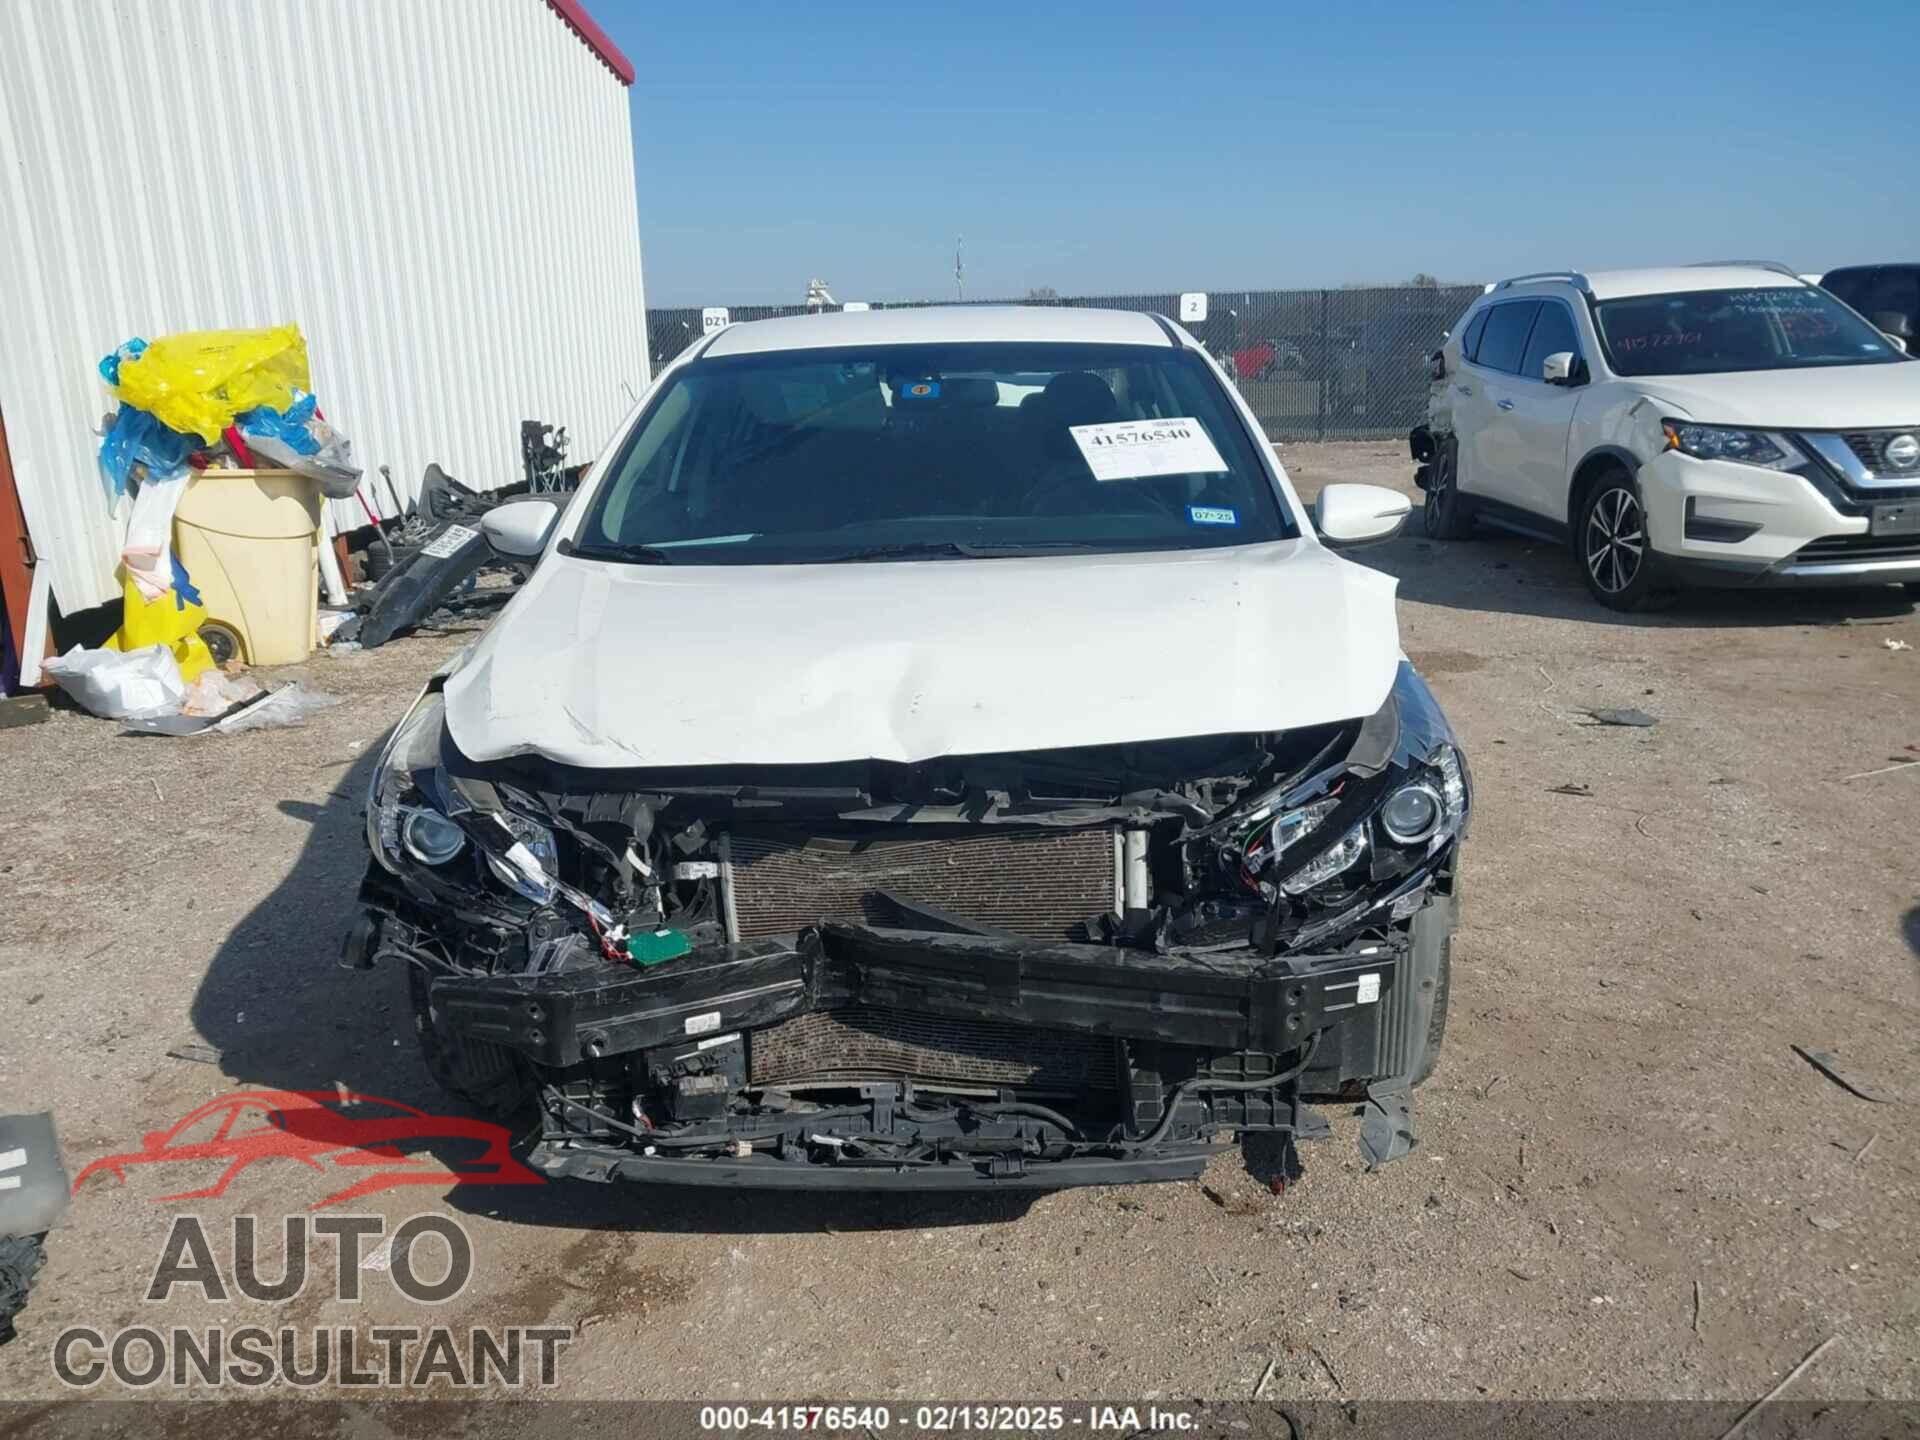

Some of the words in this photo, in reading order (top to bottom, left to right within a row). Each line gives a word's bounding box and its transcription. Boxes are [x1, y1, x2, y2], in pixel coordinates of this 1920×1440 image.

[1190, 301, 1198, 312] 2
[705, 316, 727, 327] DZ1
[1091, 428, 1191, 446] 41576540
